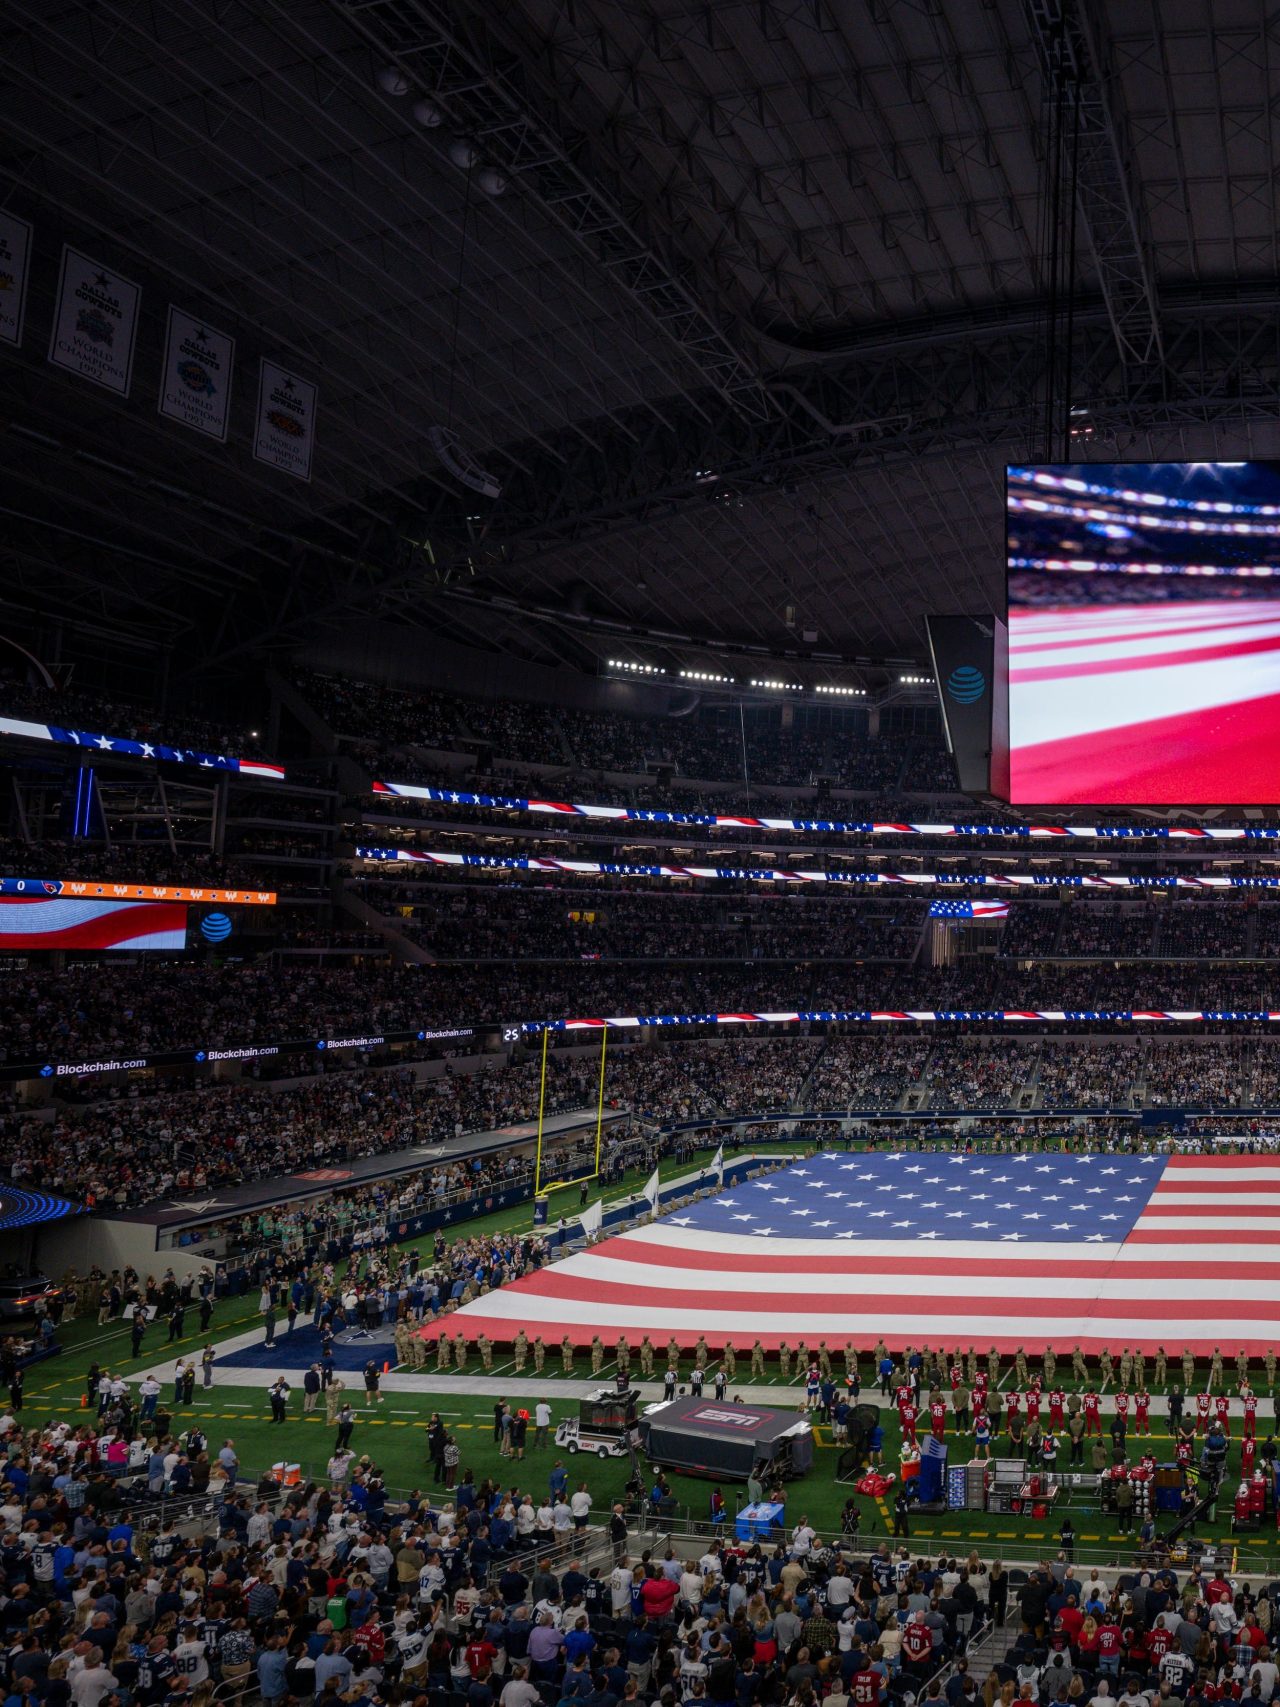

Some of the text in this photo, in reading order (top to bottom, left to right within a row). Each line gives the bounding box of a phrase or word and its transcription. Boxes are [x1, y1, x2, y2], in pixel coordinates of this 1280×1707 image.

[75, 288, 123, 319] COWBOYS
[81, 281, 120, 308] DALLAS
[73, 335, 113, 362] WORLD
[184, 338, 217, 361] DALLAS
[58, 340, 125, 379] CHAMPIONS
[79, 361, 104, 379] 1992
[179, 388, 213, 411] WORLD
[274, 387, 303, 406] DALLAS
[166, 393, 223, 425] CHAMPIONS
[270, 435, 300, 453] WORLD
[16, 880, 26, 892] 0
[327, 1035, 385, 1050] Blockchain.com
[425, 1028, 473, 1040] Blockchain.com
[504, 1028, 519, 1042] 25
[208, 1046, 279, 1061] Blockchain.com
[57, 1057, 146, 1076] Blockchain.com
[694, 1408, 762, 1426] ESPN
[879, 1574, 888, 1587] 4
[911, 1637, 921, 1650] 10
[1103, 1639, 1113, 1649] 97
[1153, 1642, 1166, 1655] 40
[176, 1657, 198, 1673] 88
[474, 1653, 480, 1666] 1
[1165, 1667, 1183, 1686] 82
[855, 1685, 874, 1702] 21
